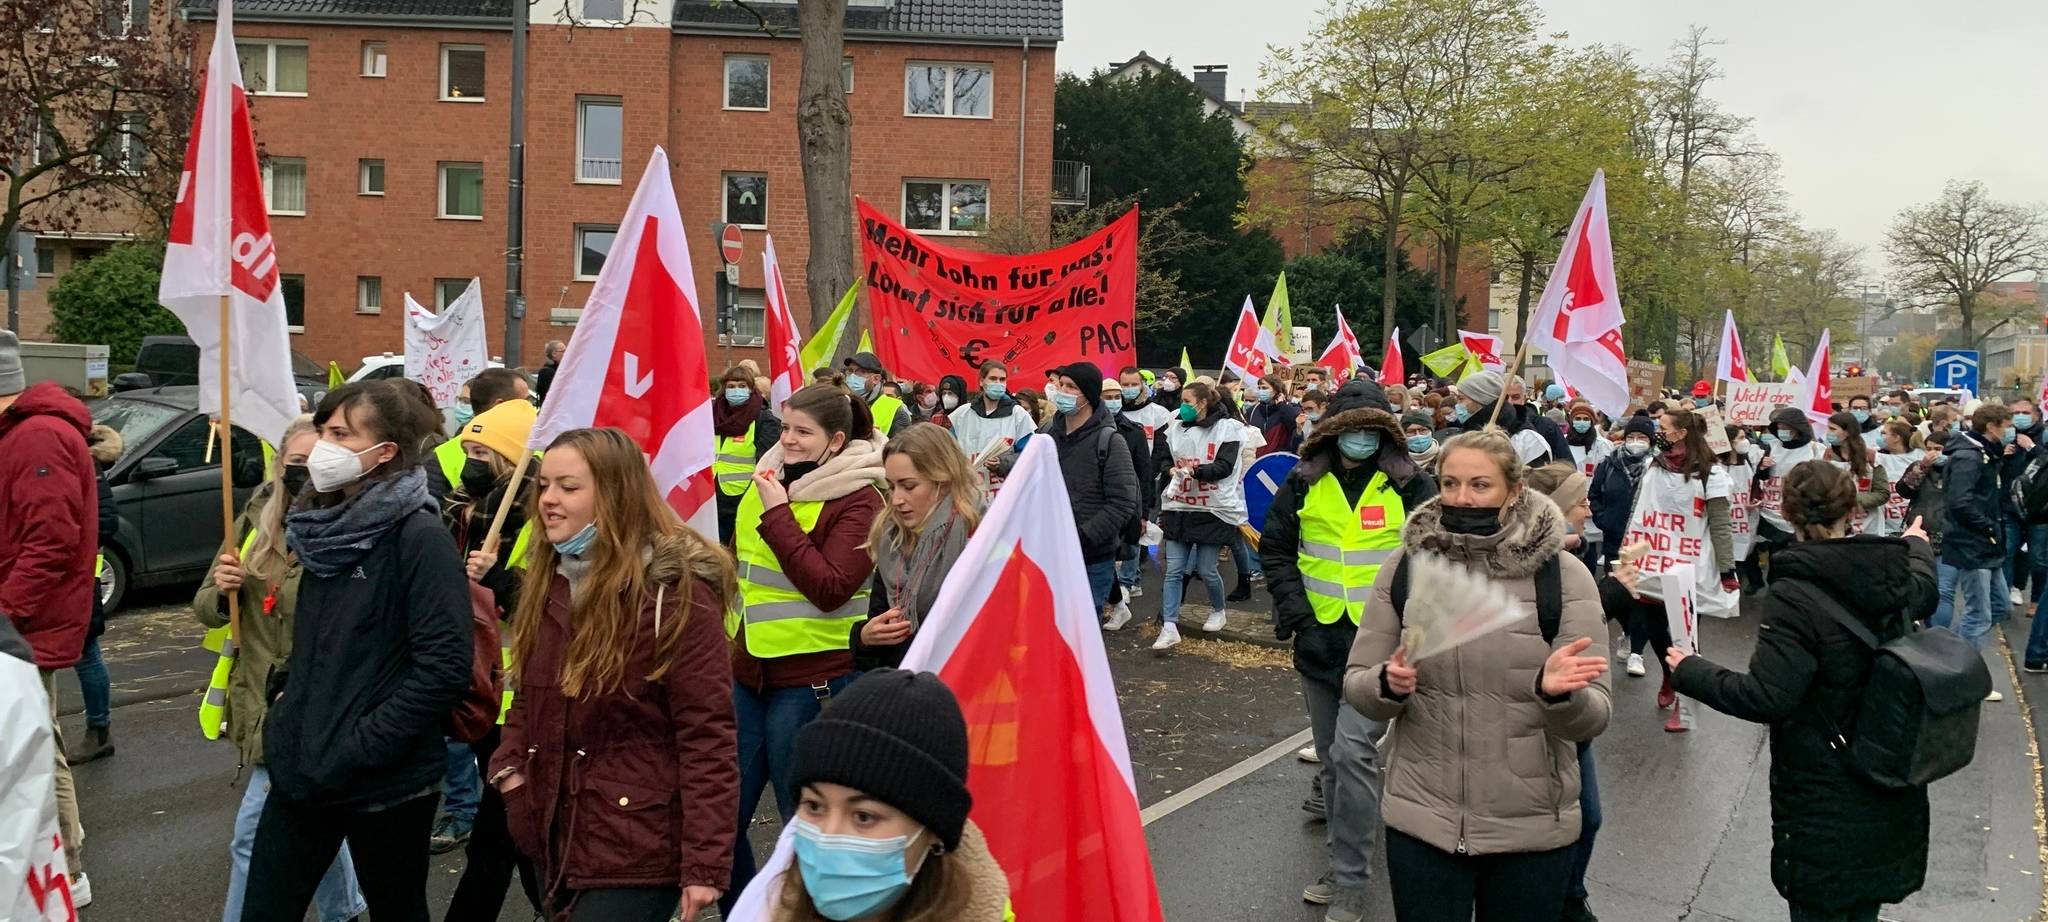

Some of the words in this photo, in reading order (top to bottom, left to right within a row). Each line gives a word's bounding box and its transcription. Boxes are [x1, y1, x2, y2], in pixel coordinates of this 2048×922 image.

[865, 217, 930, 269] Mehr
[936, 255, 998, 291] Lohn
[1008, 264, 1053, 290] für
[935, 296, 987, 324] sich
[1048, 274, 1109, 314] alle!
[1080, 320, 1137, 356] PAC
[1733, 386, 1769, 402] Nicht
[1769, 388, 1795, 404] ohne
[1729, 403, 1765, 424] Geld!
[1642, 511, 1686, 532] WIR
[1680, 537, 1702, 557] ES
